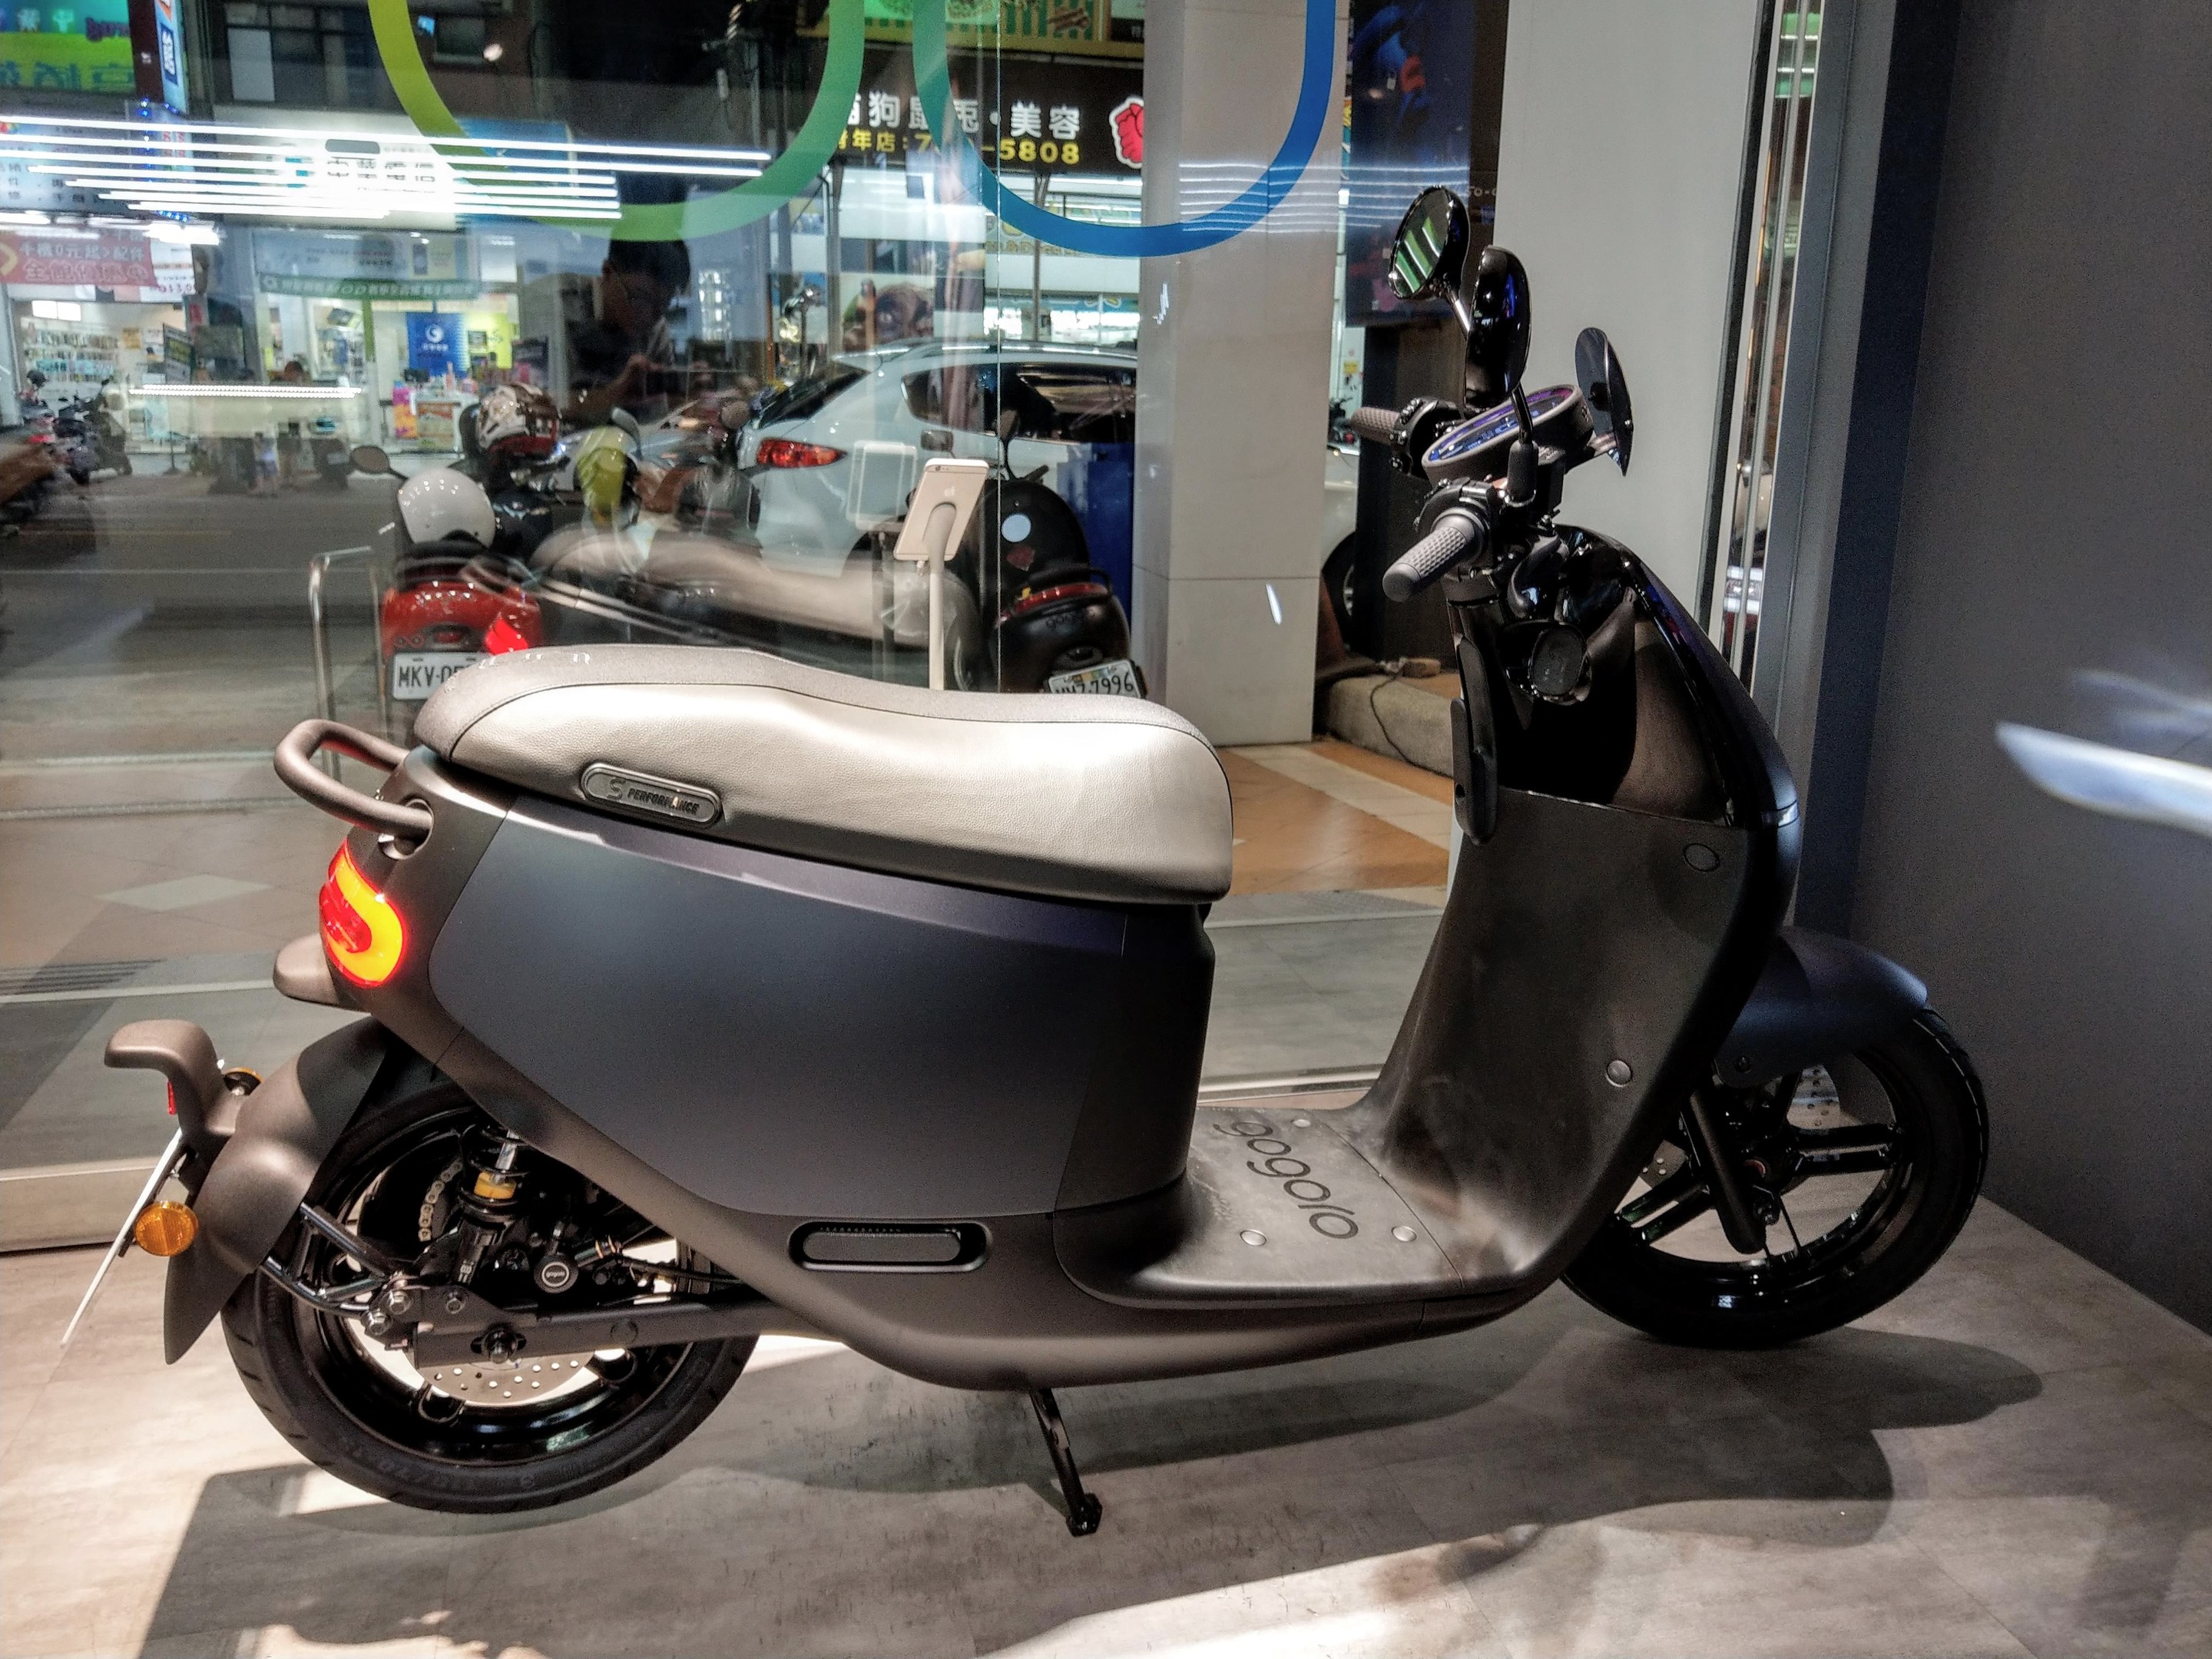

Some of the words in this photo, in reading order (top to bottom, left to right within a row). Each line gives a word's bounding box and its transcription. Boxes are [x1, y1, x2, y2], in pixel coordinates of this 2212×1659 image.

[399, 665, 469, 687] MKV-0
[1055, 671, 1134, 694] -7996
[1214, 1121, 1359, 1240] gogoro
